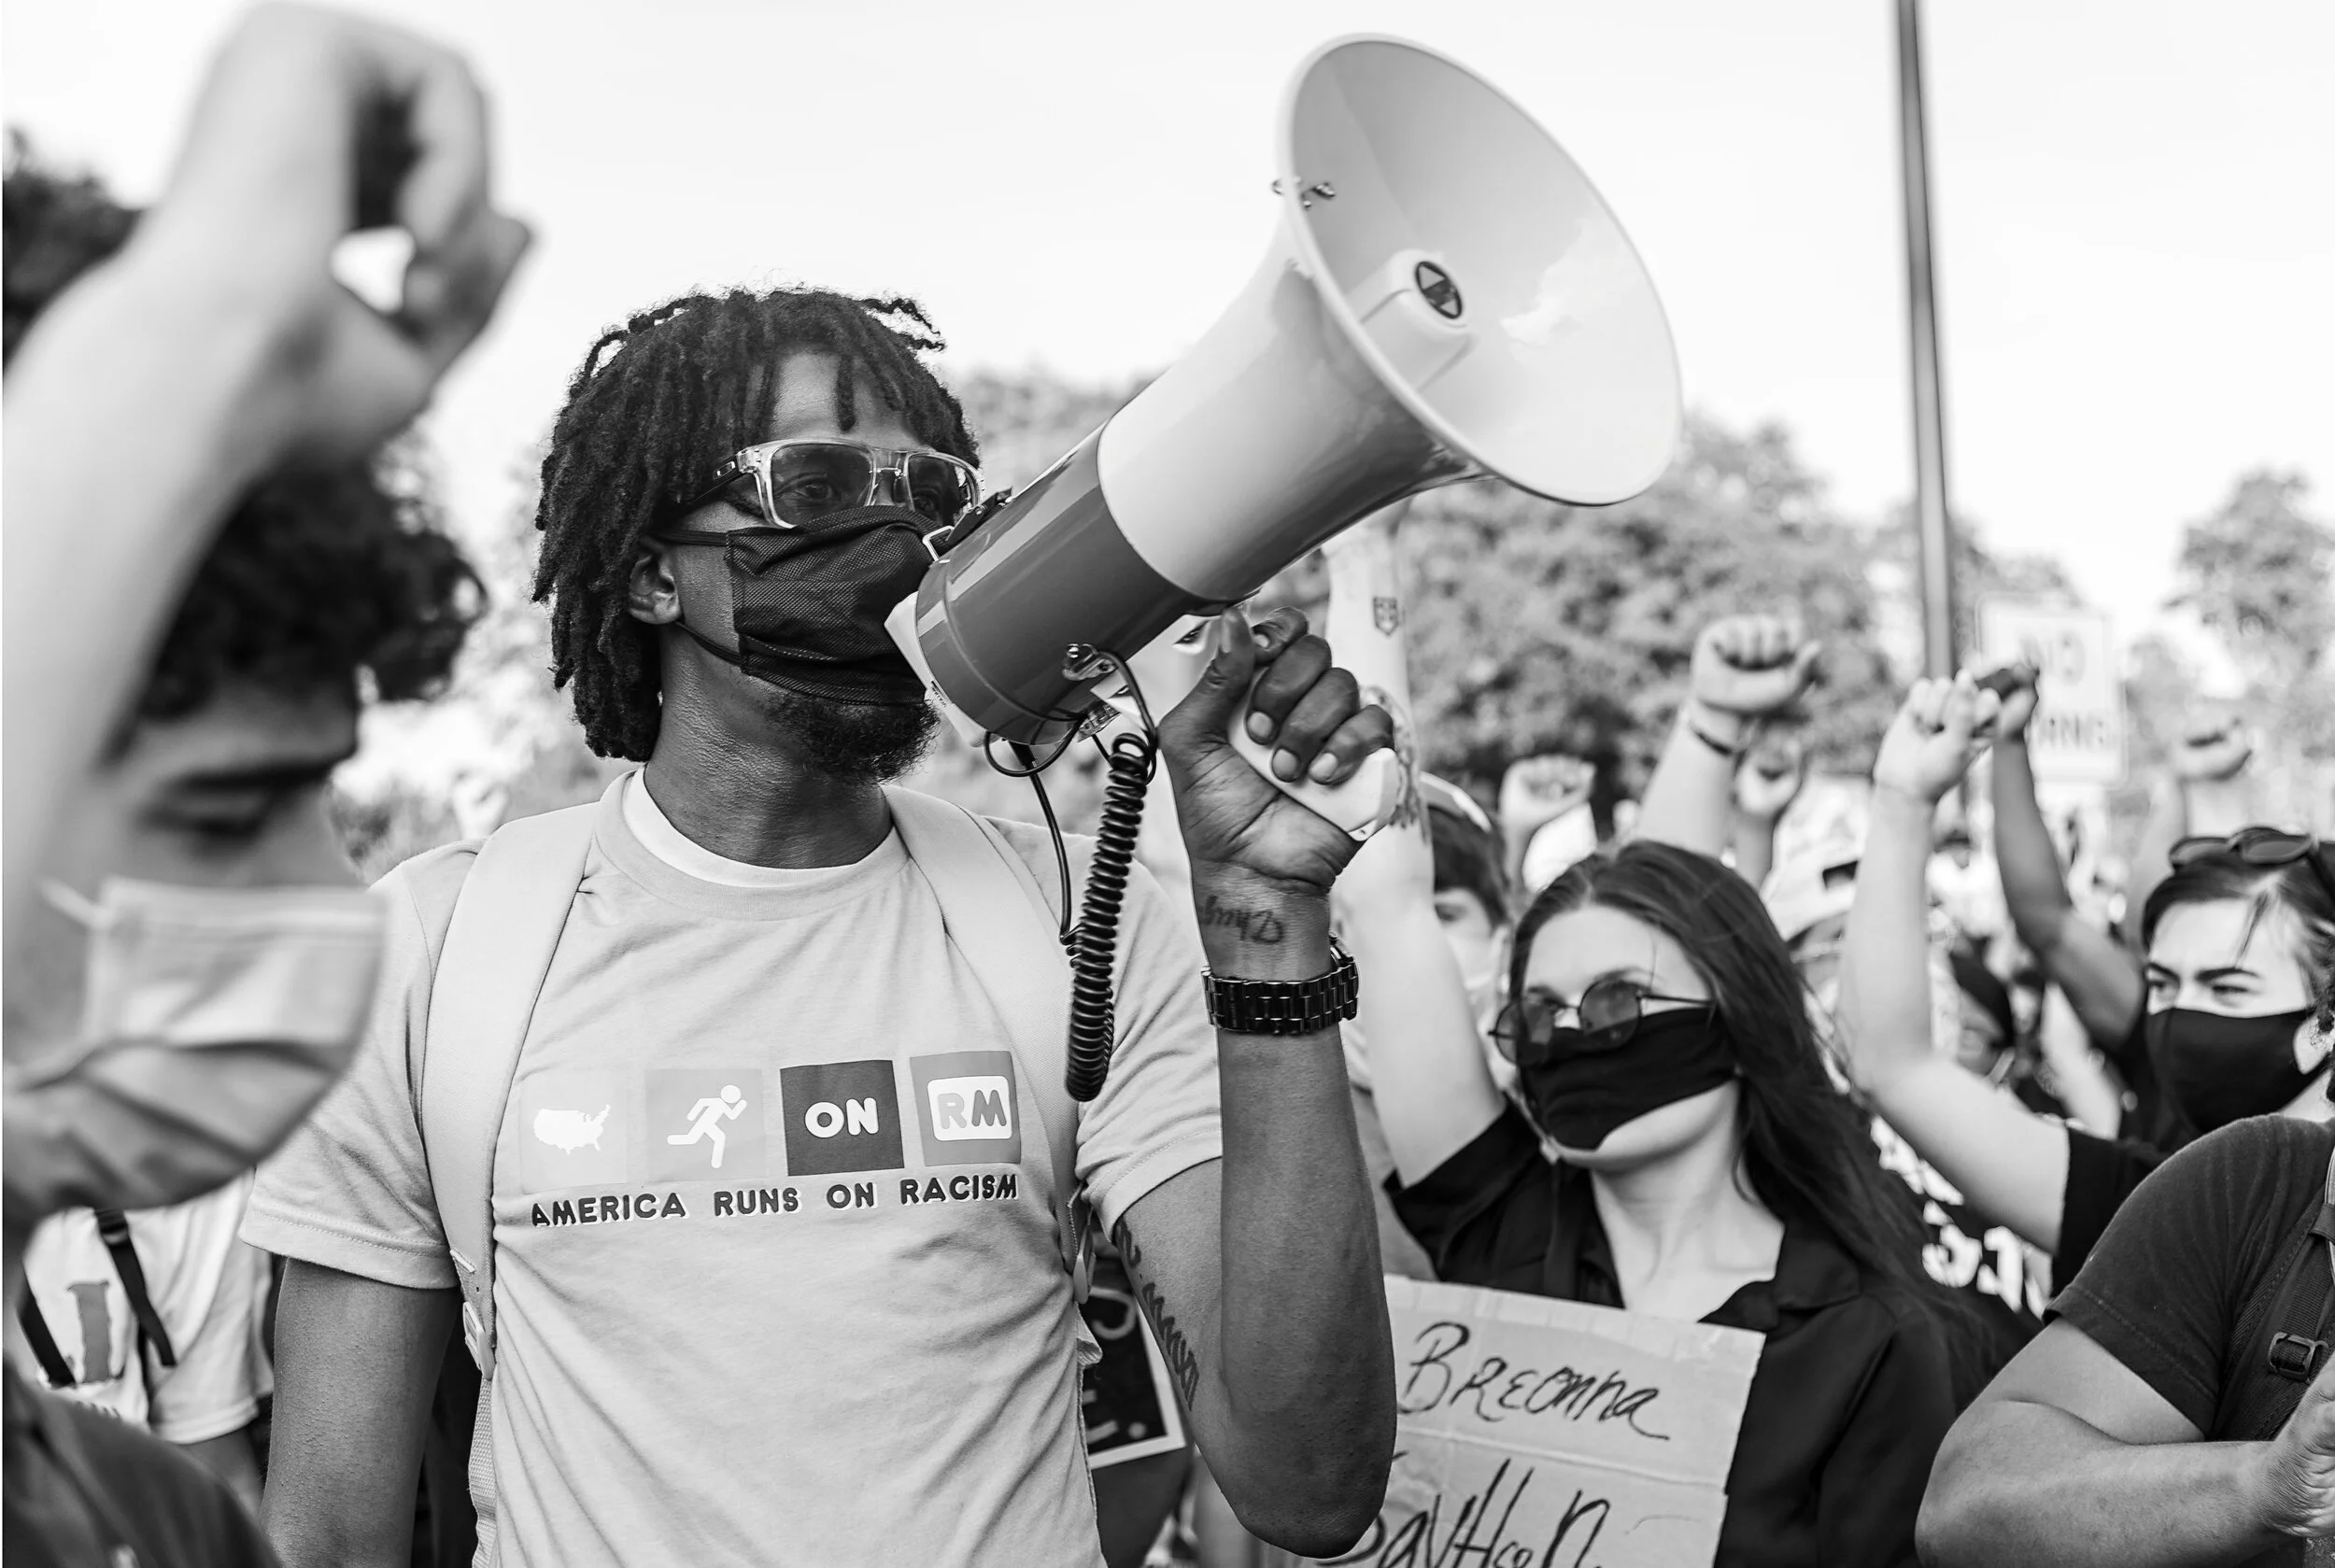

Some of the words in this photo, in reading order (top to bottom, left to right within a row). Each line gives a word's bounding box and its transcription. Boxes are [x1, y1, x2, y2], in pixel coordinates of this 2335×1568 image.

[804, 1097, 879, 1138] ON
[938, 1090, 1007, 1129] RM
[531, 1192, 689, 1227] AMERICA
[714, 1187, 801, 1217] RUNS
[826, 1181, 878, 1210] ON
[900, 1174, 1019, 1206] RACISM
